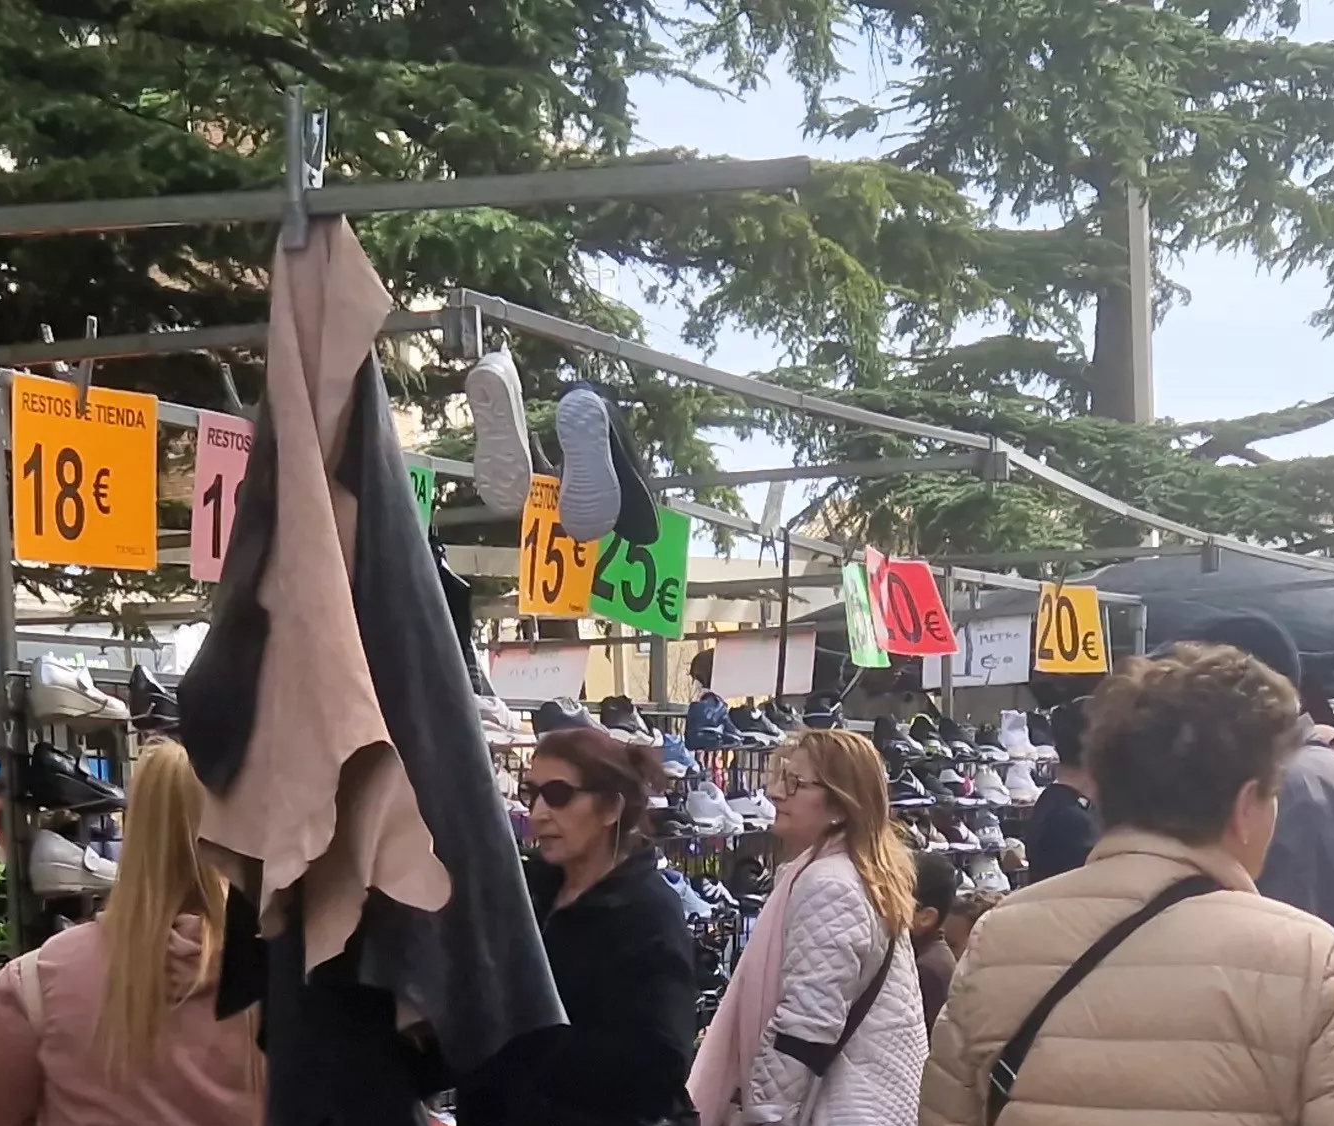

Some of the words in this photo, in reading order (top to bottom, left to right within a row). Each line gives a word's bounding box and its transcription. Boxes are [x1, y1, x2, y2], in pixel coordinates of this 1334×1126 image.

[22, 392, 71, 417] RESTOS
[97, 403, 146, 429] TIENDA
[207, 427, 252, 452] RESTOS
[202, 473, 244, 559] 1
[1038, 593, 1099, 662] 20€
